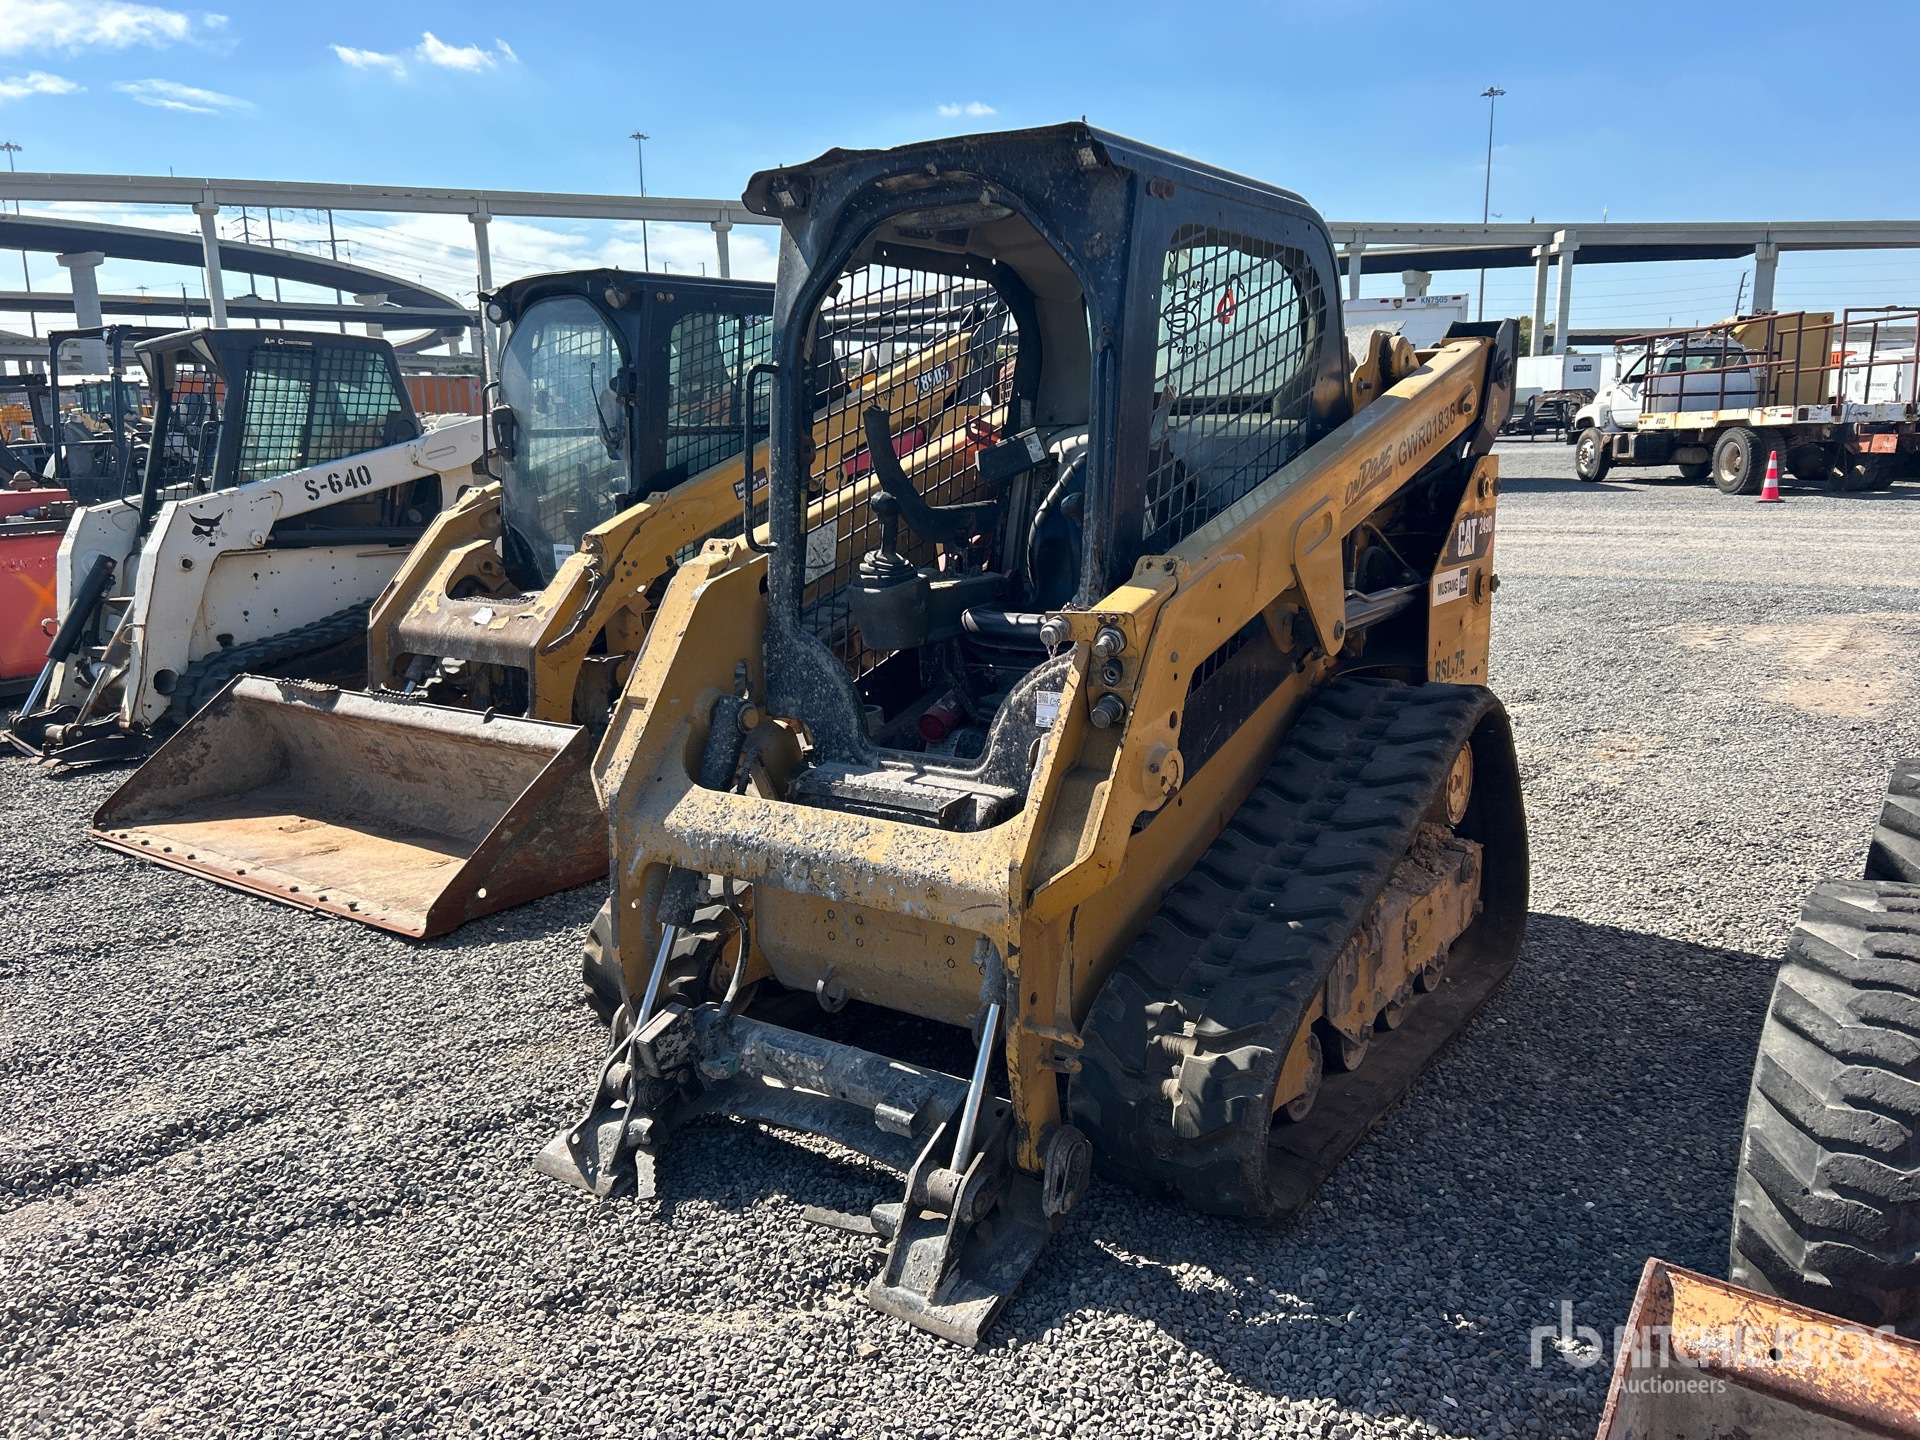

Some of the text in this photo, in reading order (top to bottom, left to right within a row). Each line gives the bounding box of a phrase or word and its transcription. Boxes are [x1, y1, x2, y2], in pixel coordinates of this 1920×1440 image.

[1420, 296, 1449, 304] KN7505
[1398, 401, 1456, 467] GWR01836
[304, 465, 372, 500] S-640
[1457, 515, 1493, 558] CAT 249D
[1437, 577, 1459, 596] MUSTANG
